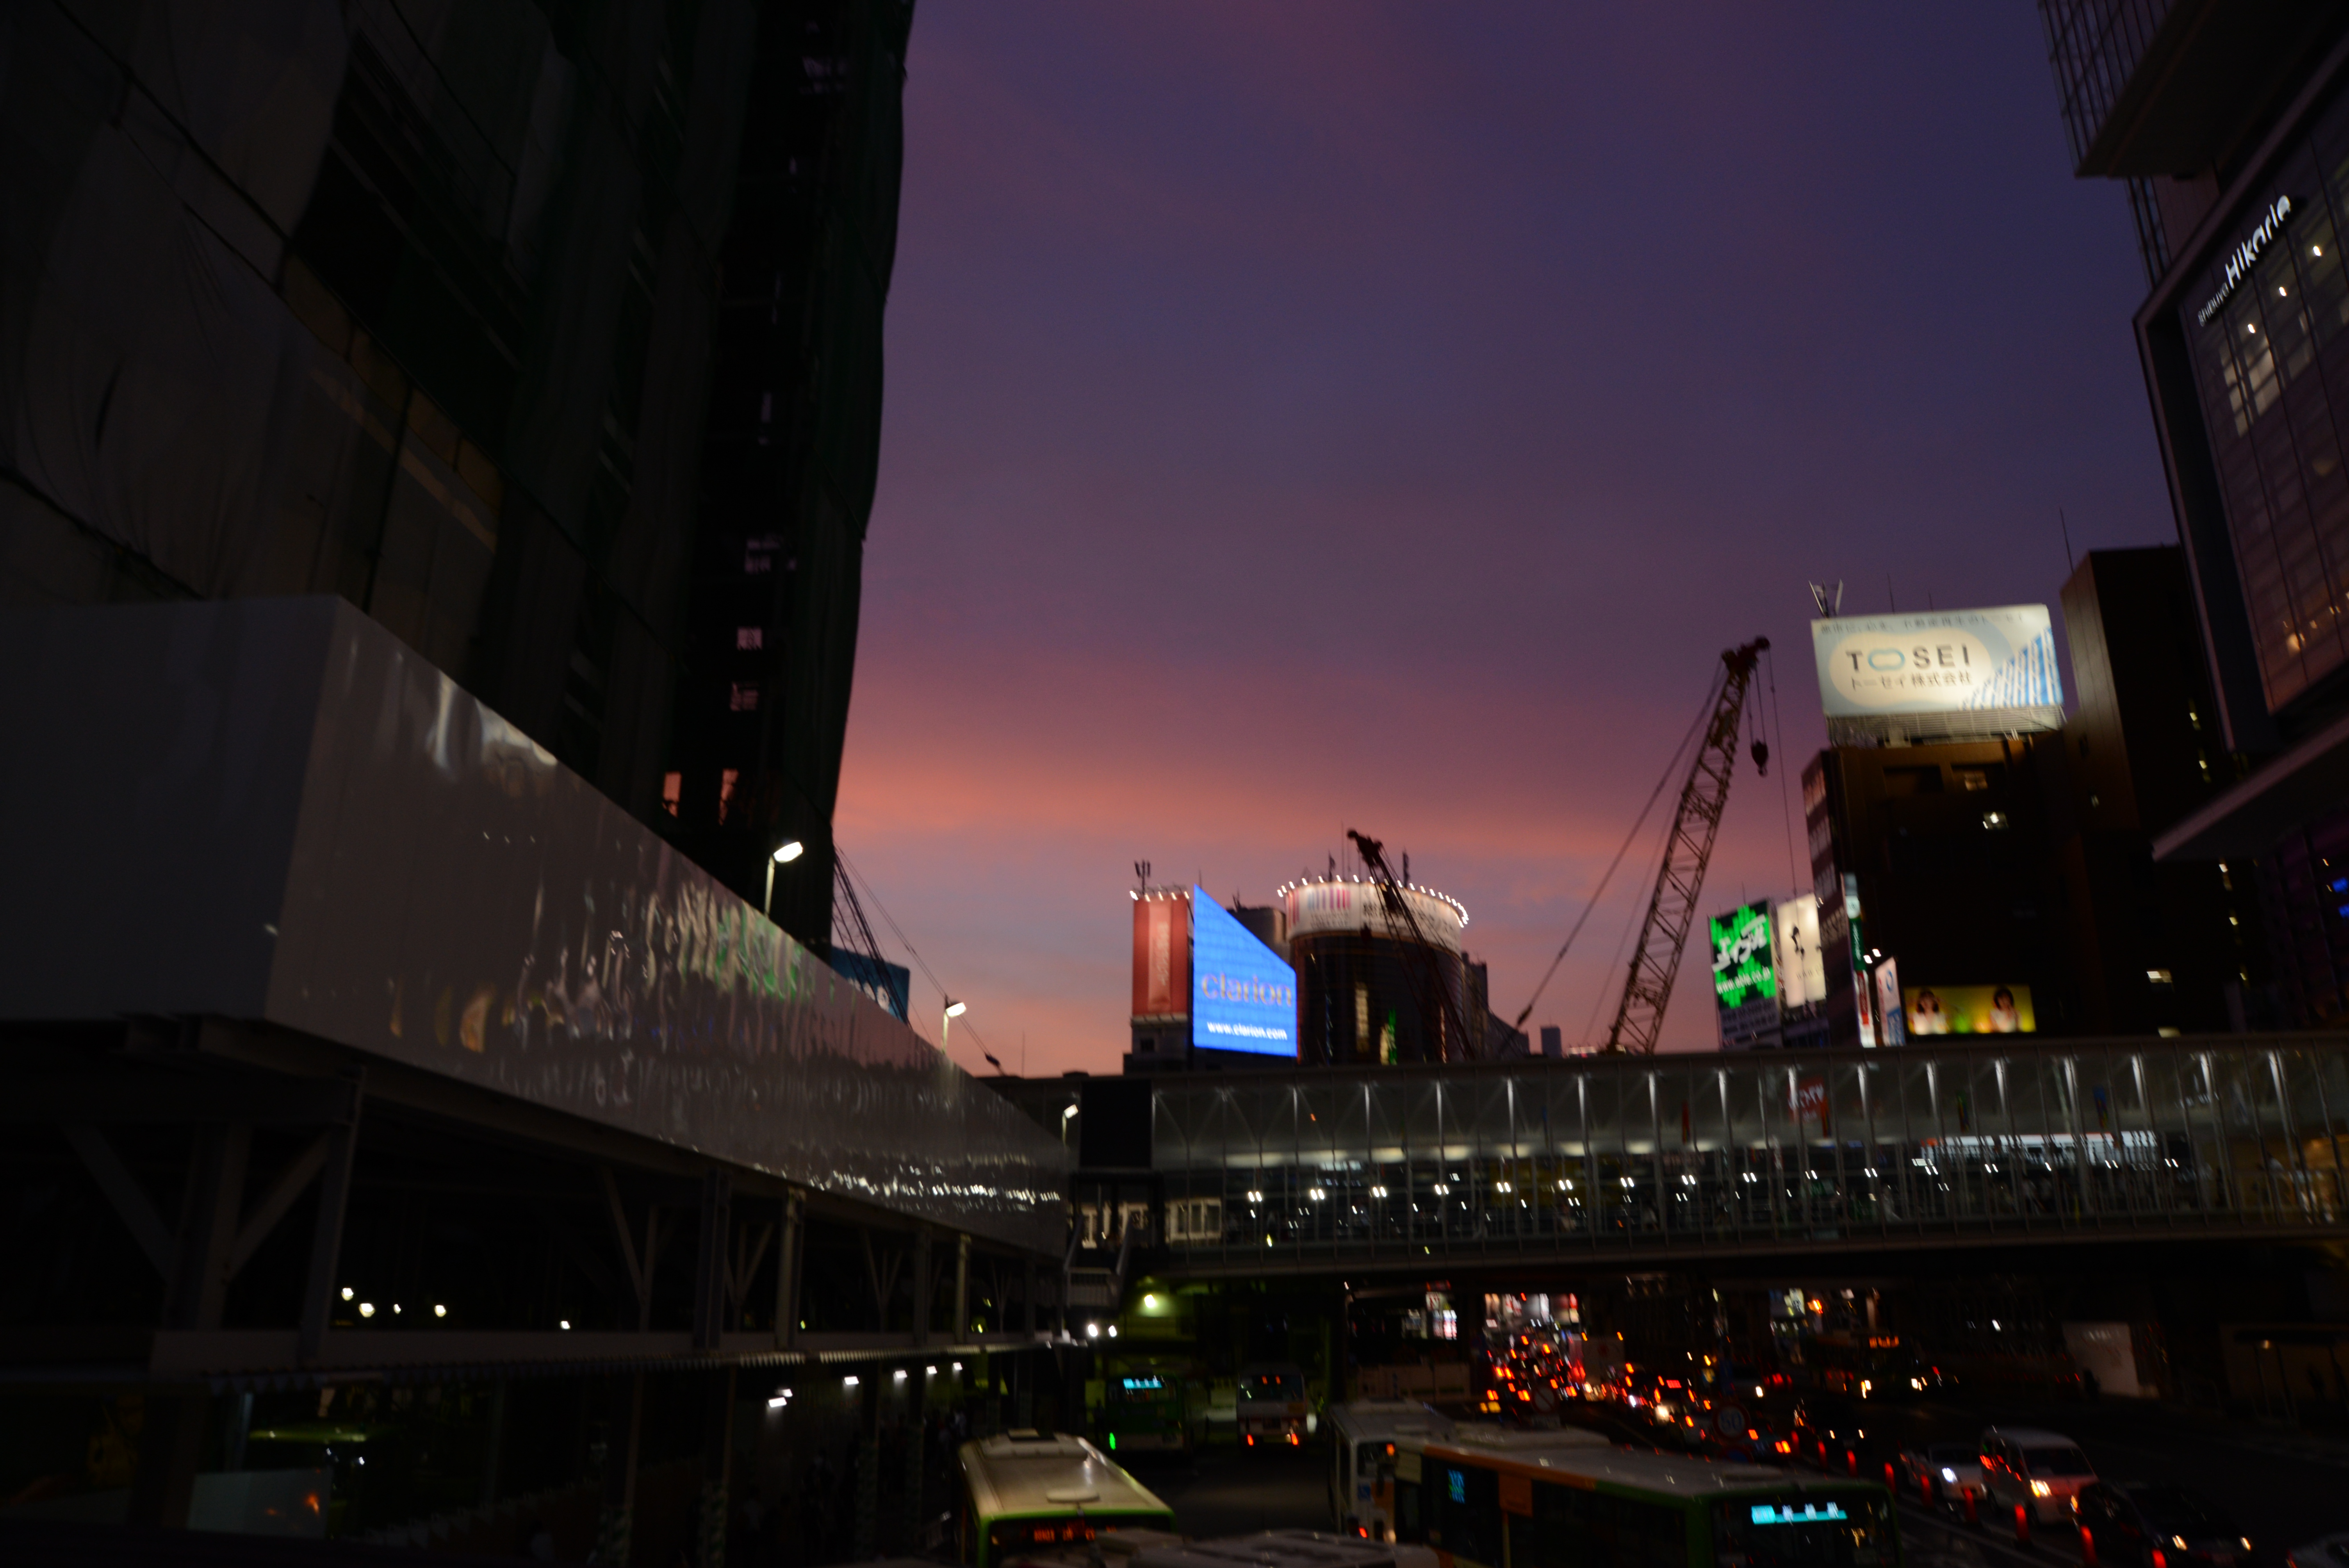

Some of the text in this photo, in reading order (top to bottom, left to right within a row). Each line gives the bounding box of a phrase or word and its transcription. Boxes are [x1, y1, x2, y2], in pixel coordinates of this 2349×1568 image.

[2225, 194, 2291, 289] Hikarie
[1846, 643, 1970, 672] TOSEI
[1207, 1021, 1288, 1041] www.clarion.com
